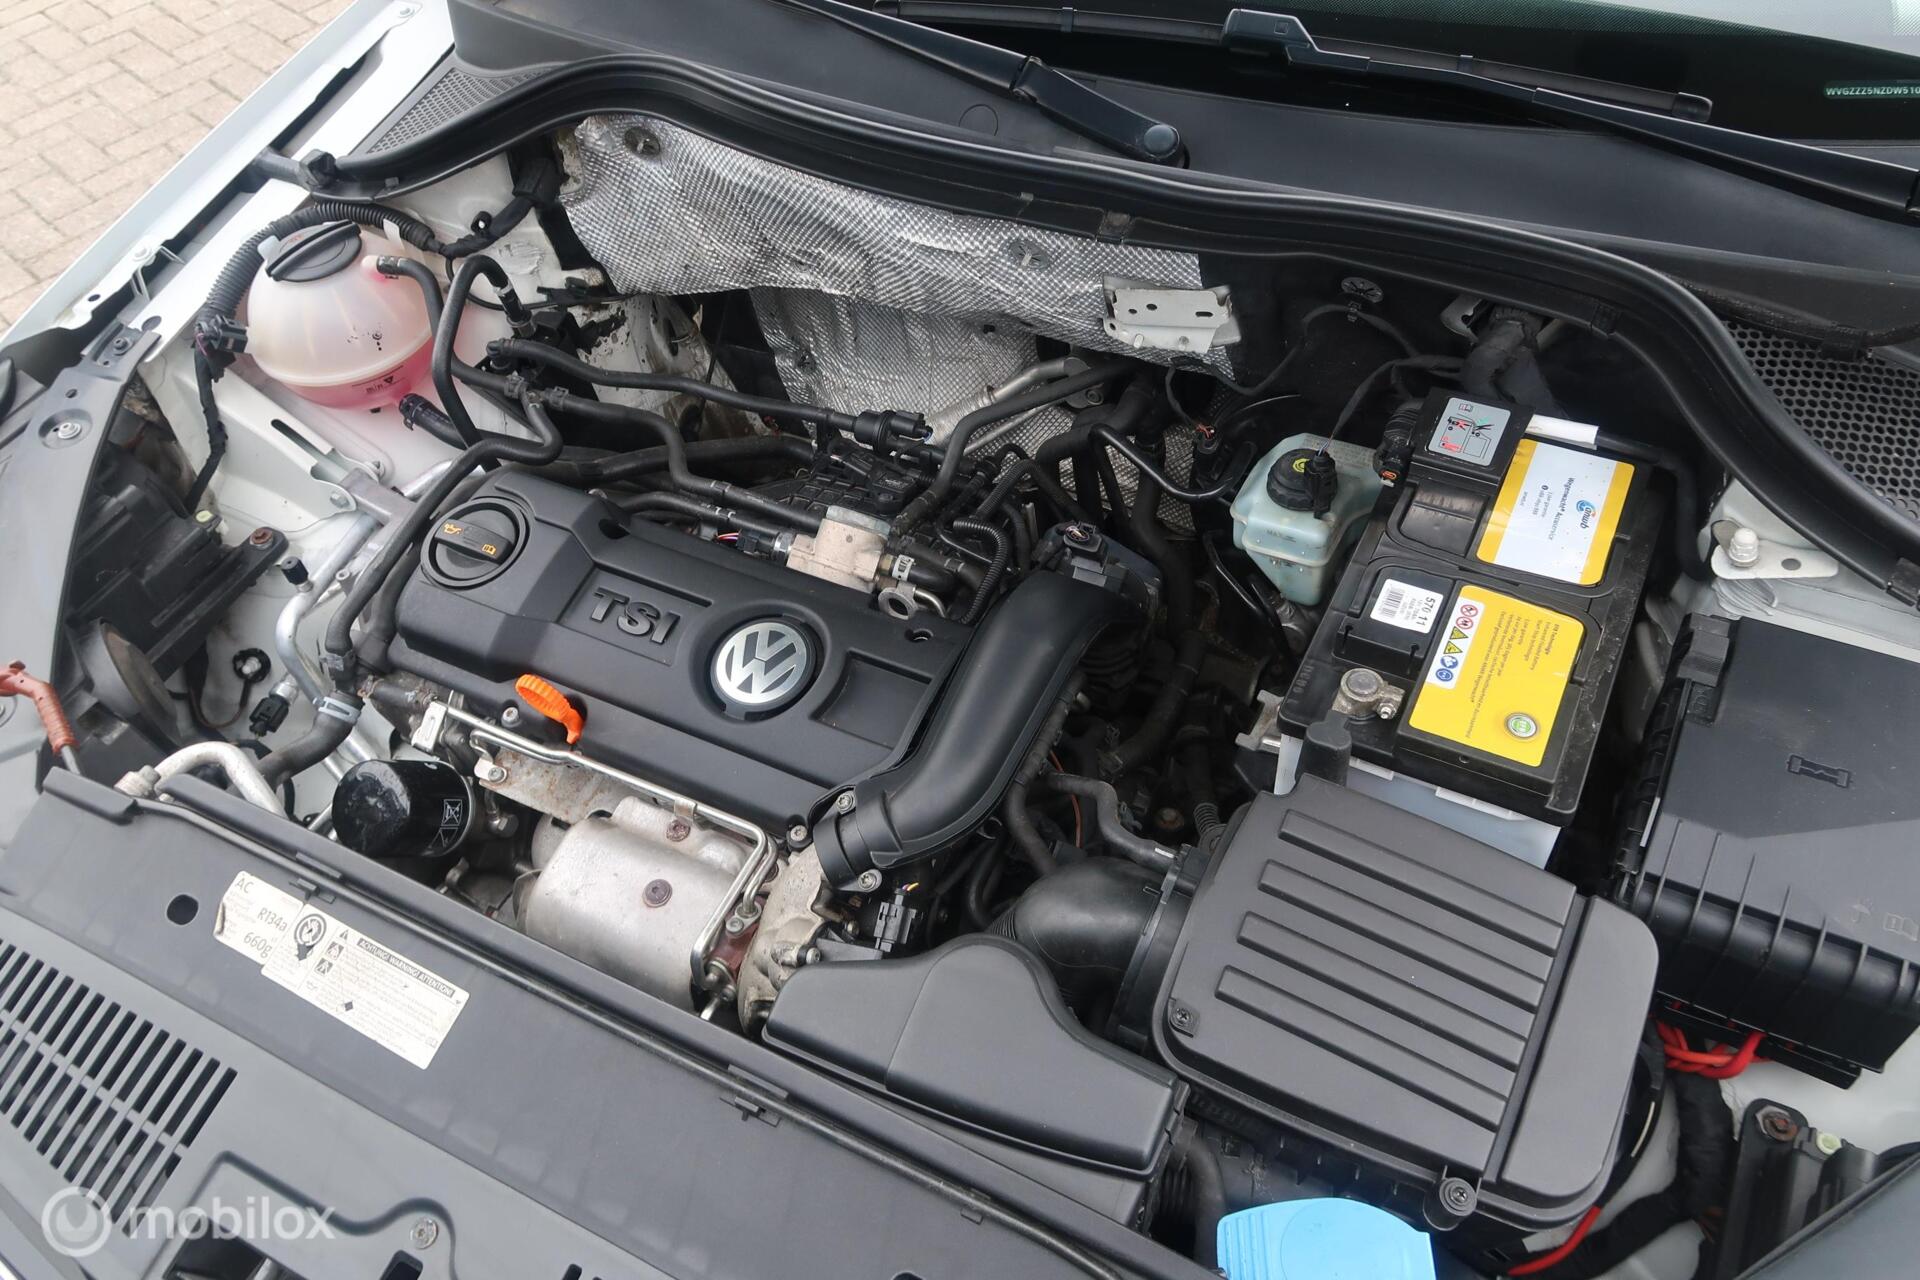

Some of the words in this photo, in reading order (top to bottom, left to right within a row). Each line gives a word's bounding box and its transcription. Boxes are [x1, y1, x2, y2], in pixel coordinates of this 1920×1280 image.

[590, 587, 681, 645] TSI
[1421, 596, 1436, 614] 570
[1416, 615, 1428, 627] 11
[235, 878, 254, 894] AC
[257, 907, 288, 931] R134a
[243, 932, 273, 959] 660g
[418, 971, 454, 997] ATTENTION!
